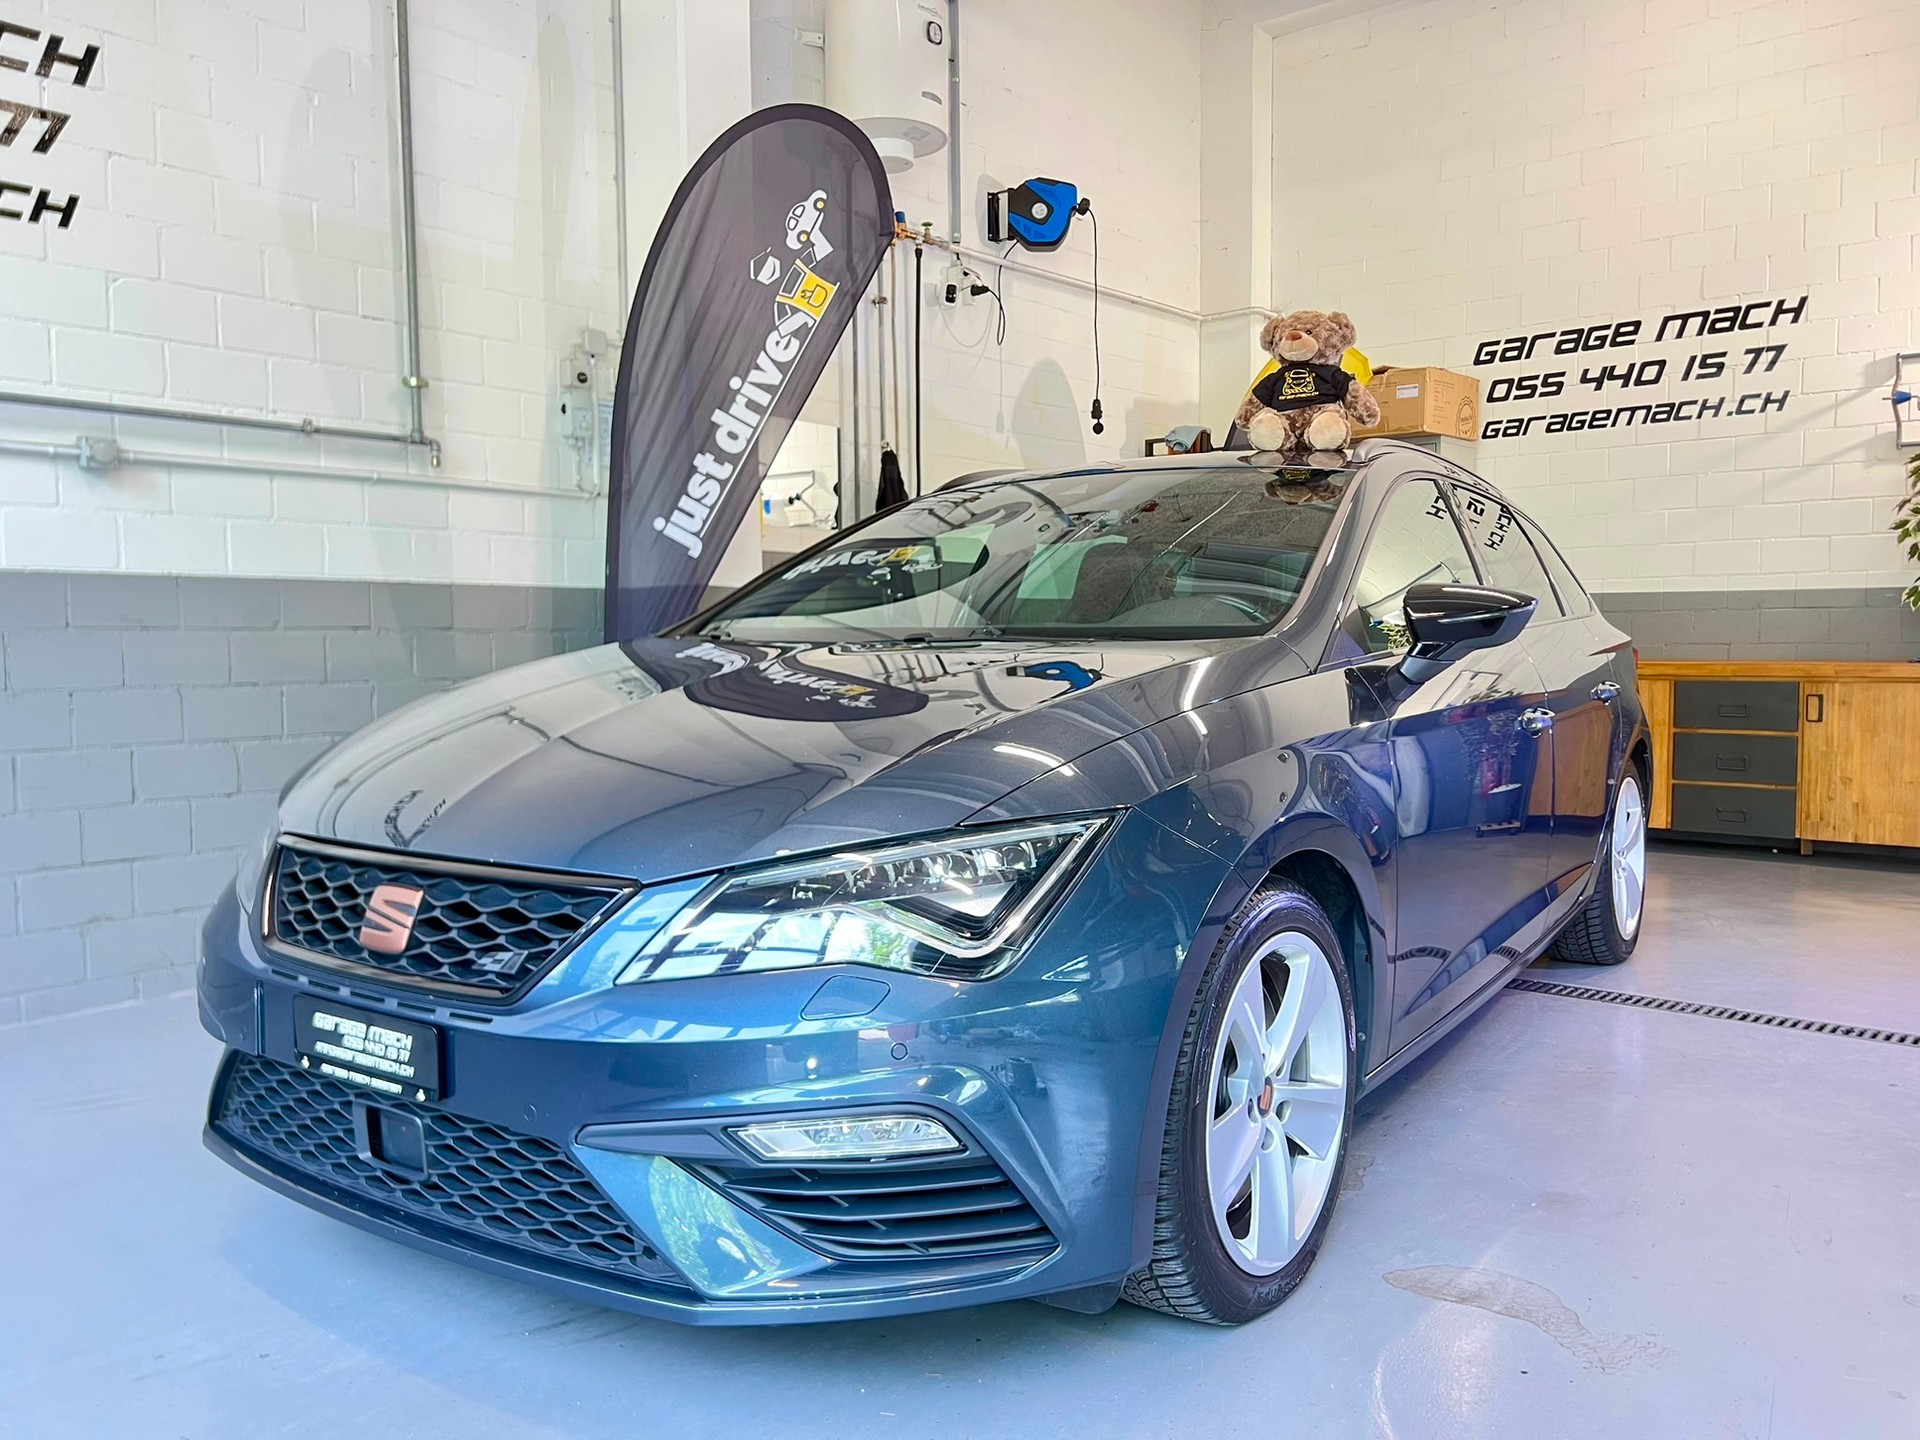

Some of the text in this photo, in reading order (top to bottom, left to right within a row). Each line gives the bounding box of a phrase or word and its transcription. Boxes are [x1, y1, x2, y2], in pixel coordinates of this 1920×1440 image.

[1485, 371, 1567, 404] 055
[1580, 359, 1667, 392] 440
[1681, 351, 1728, 382] 15
[1743, 343, 1789, 375] 77
[653, 452, 734, 559] just
